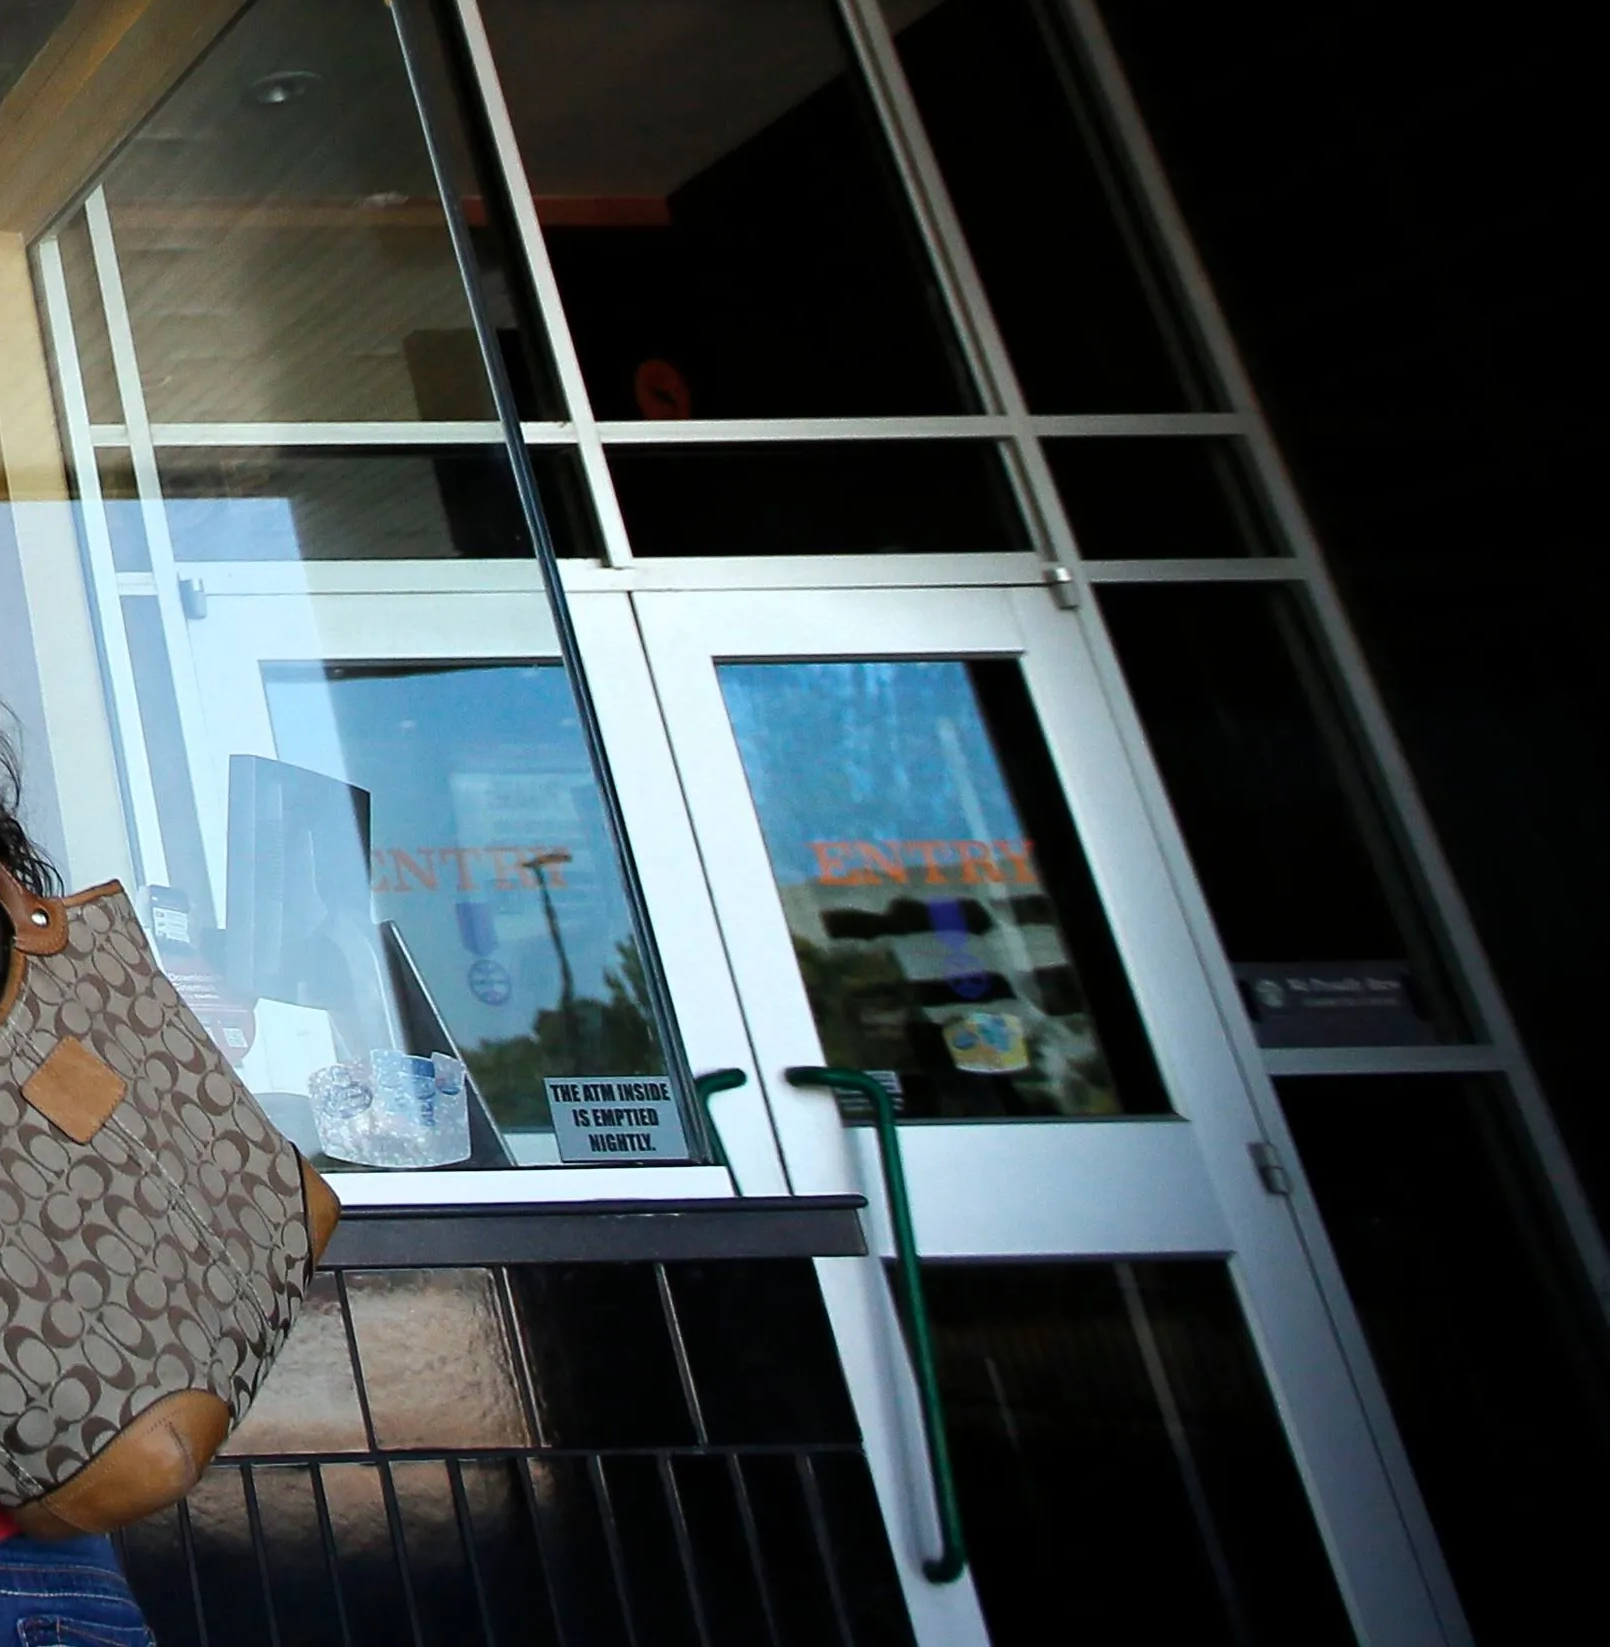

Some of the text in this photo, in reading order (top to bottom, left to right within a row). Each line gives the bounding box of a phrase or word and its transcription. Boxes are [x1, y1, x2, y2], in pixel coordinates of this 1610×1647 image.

[805, 839, 1039, 887] ENTRY
[550, 1083, 670, 1103] THE ATM INSIDE
[573, 1108, 659, 1127] IS EMPTIED
[589, 1133, 656, 1152] NIGHTLY.
